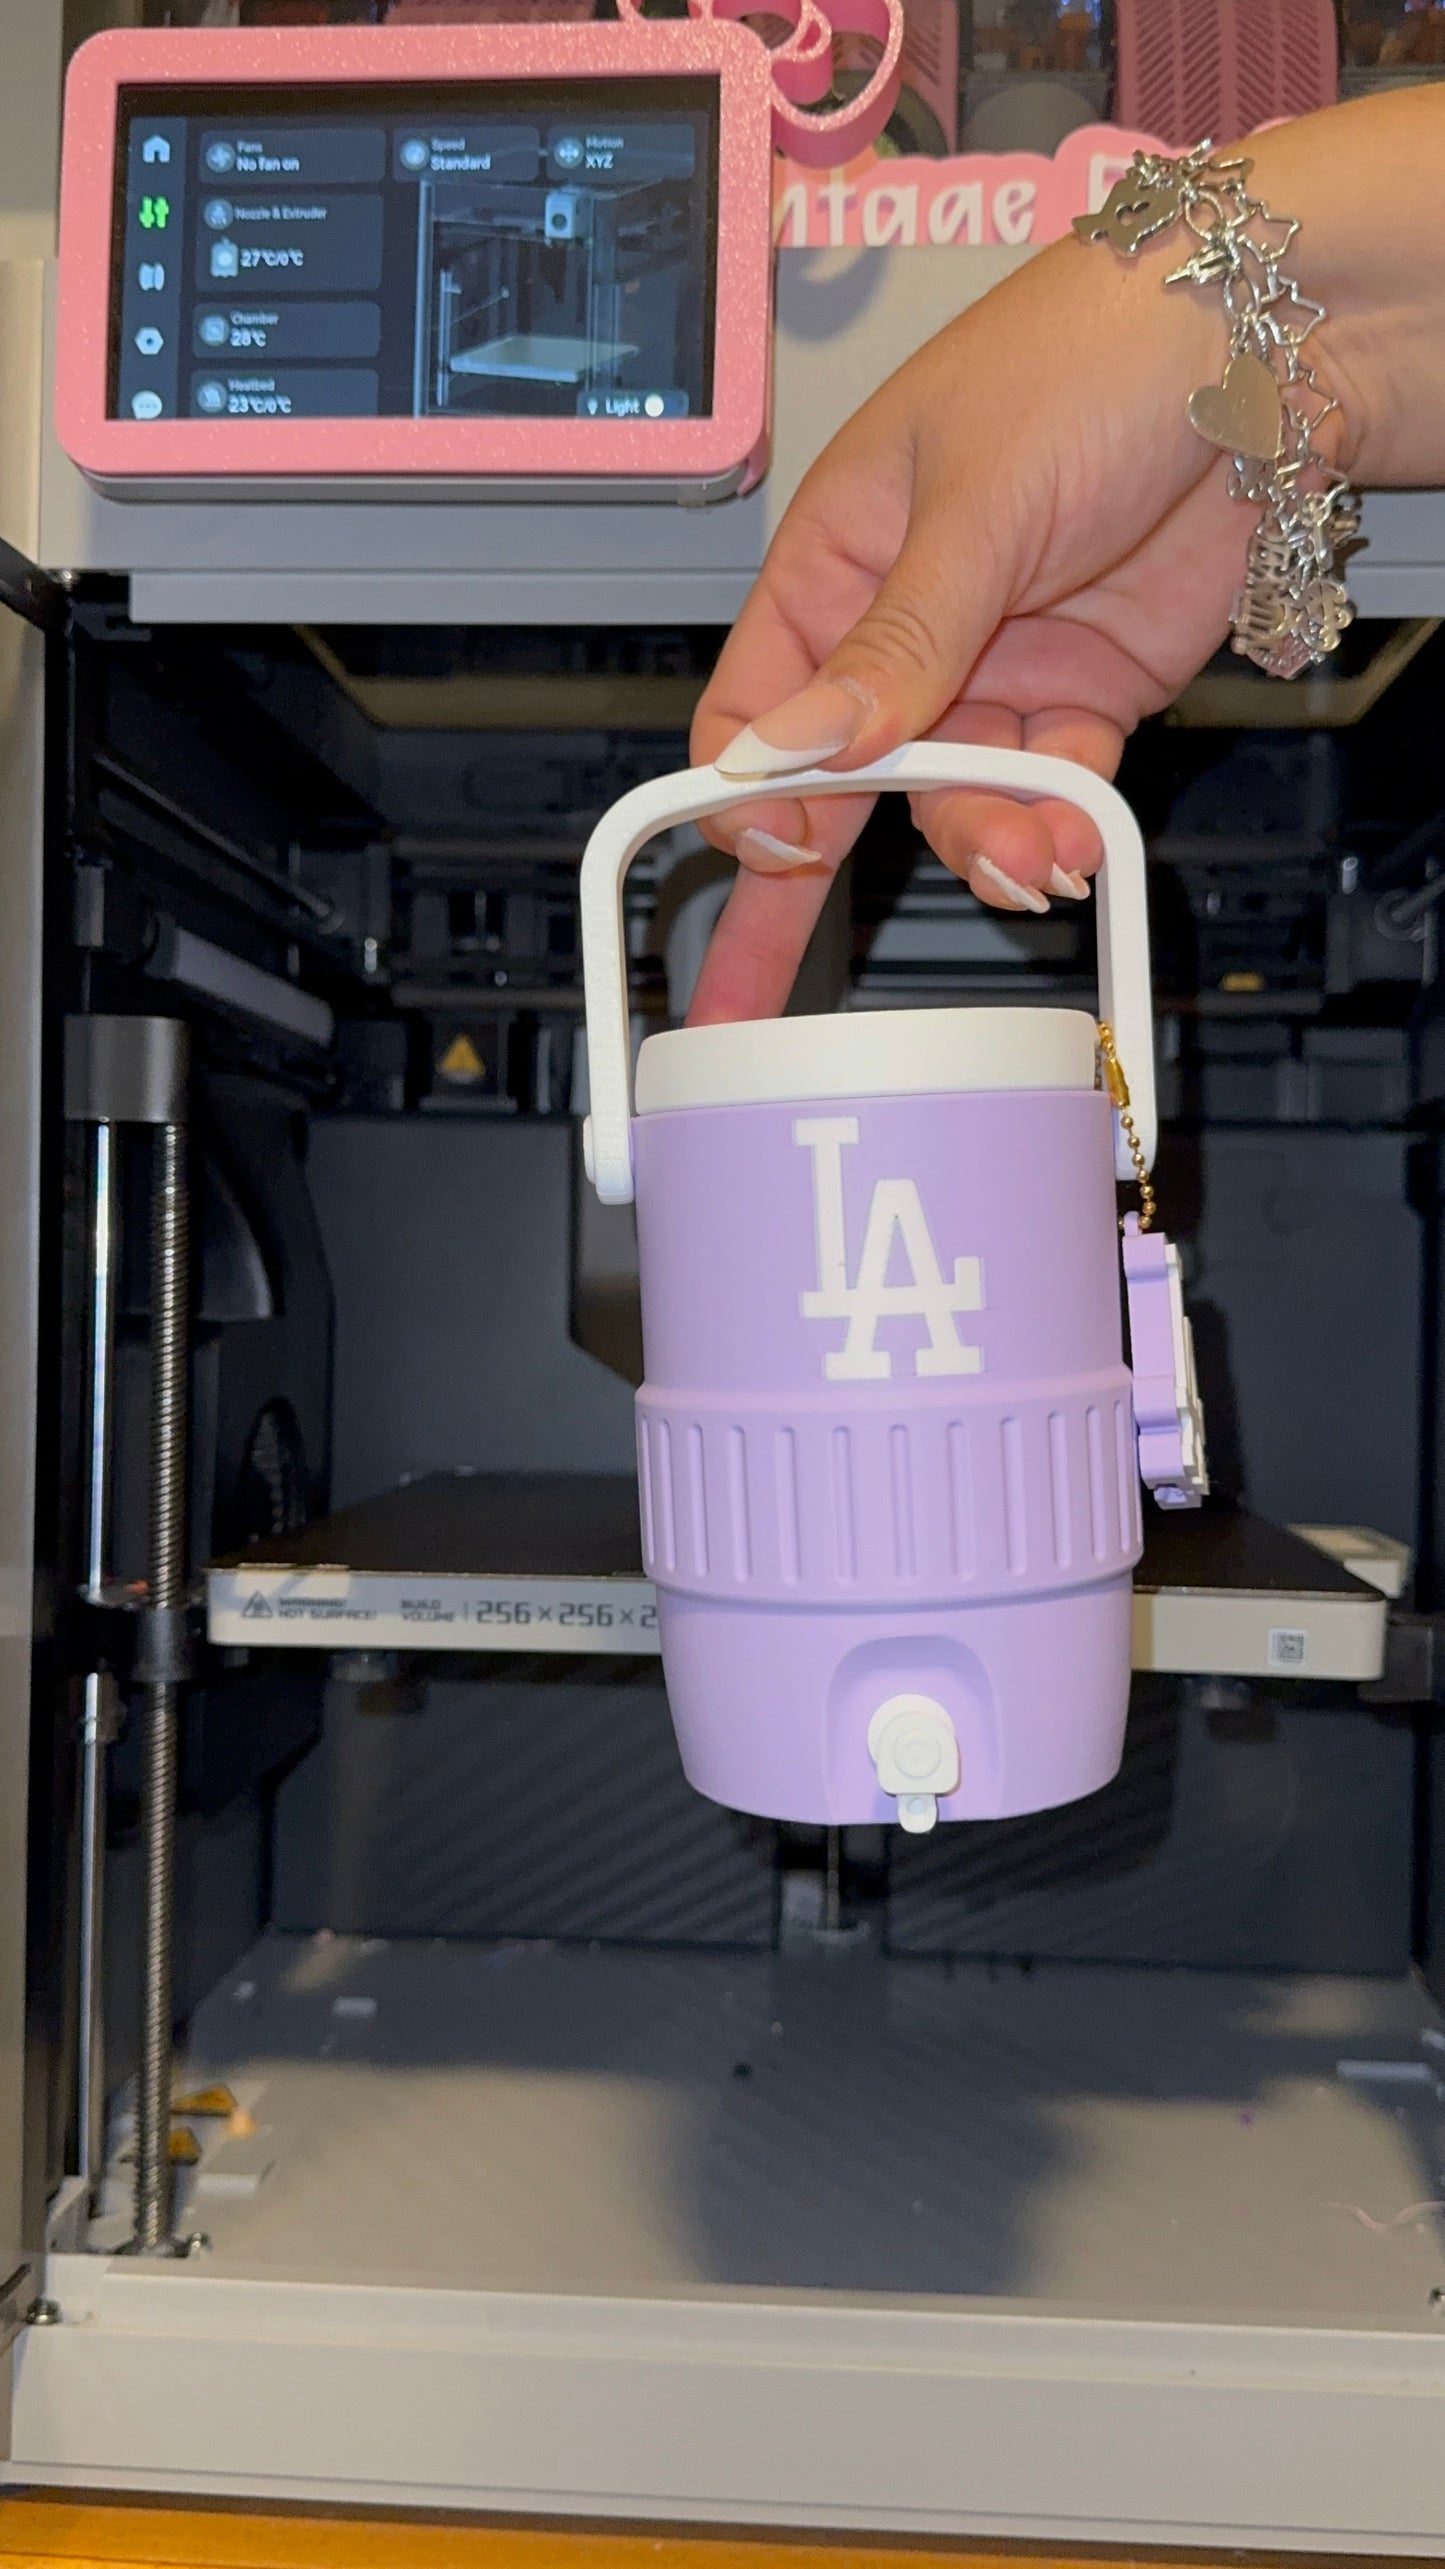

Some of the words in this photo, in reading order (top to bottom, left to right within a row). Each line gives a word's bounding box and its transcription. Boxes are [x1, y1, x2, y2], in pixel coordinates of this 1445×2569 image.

[236, 156, 257, 171] No
[259, 156, 281, 171] fan
[284, 158, 299, 171] on
[431, 154, 490, 171] Standard
[585, 155, 613, 169] XYZ
[605, 397, 640, 416] Light
[795, 1118, 983, 1379] LA
[279, 1609, 304, 1618] HOT
[402, 1611, 455, 1623] VOLUME
